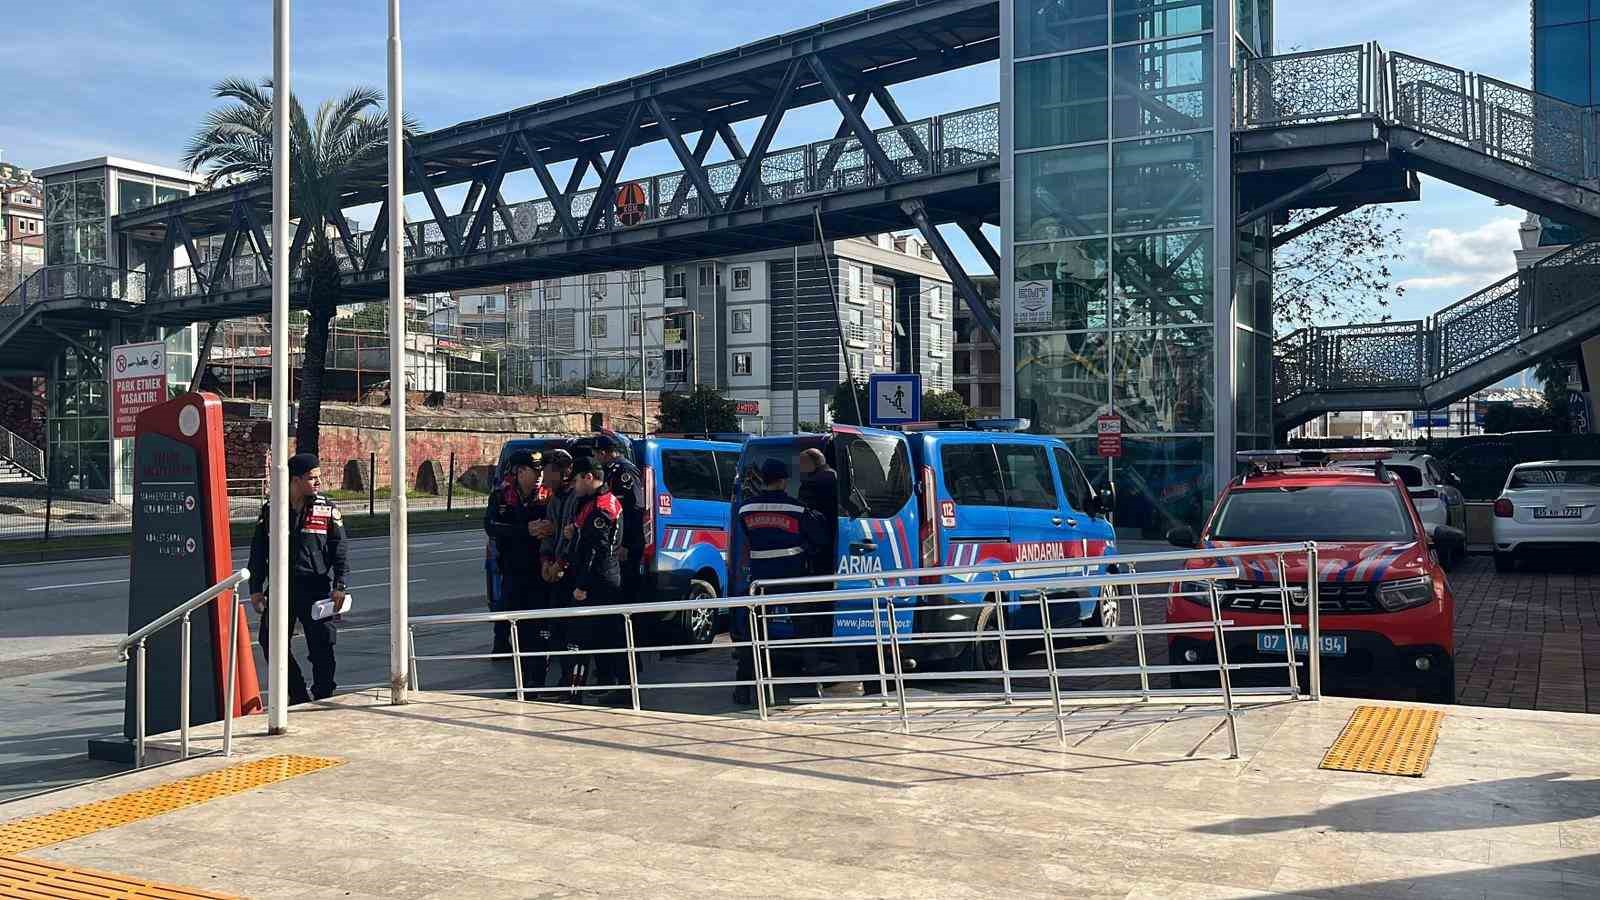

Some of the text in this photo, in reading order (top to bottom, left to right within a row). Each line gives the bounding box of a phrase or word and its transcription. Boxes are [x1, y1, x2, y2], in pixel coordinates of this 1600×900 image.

[116, 378, 161, 393] PARK ETMEK
[120, 391, 157, 405] YASAKTIR!
[660, 495, 671, 507] 112
[943, 503, 954, 517] 112
[1015, 542, 1065, 563] JANDARMA
[837, 554, 883, 576] ARMA
[1263, 634, 1280, 650] 07
